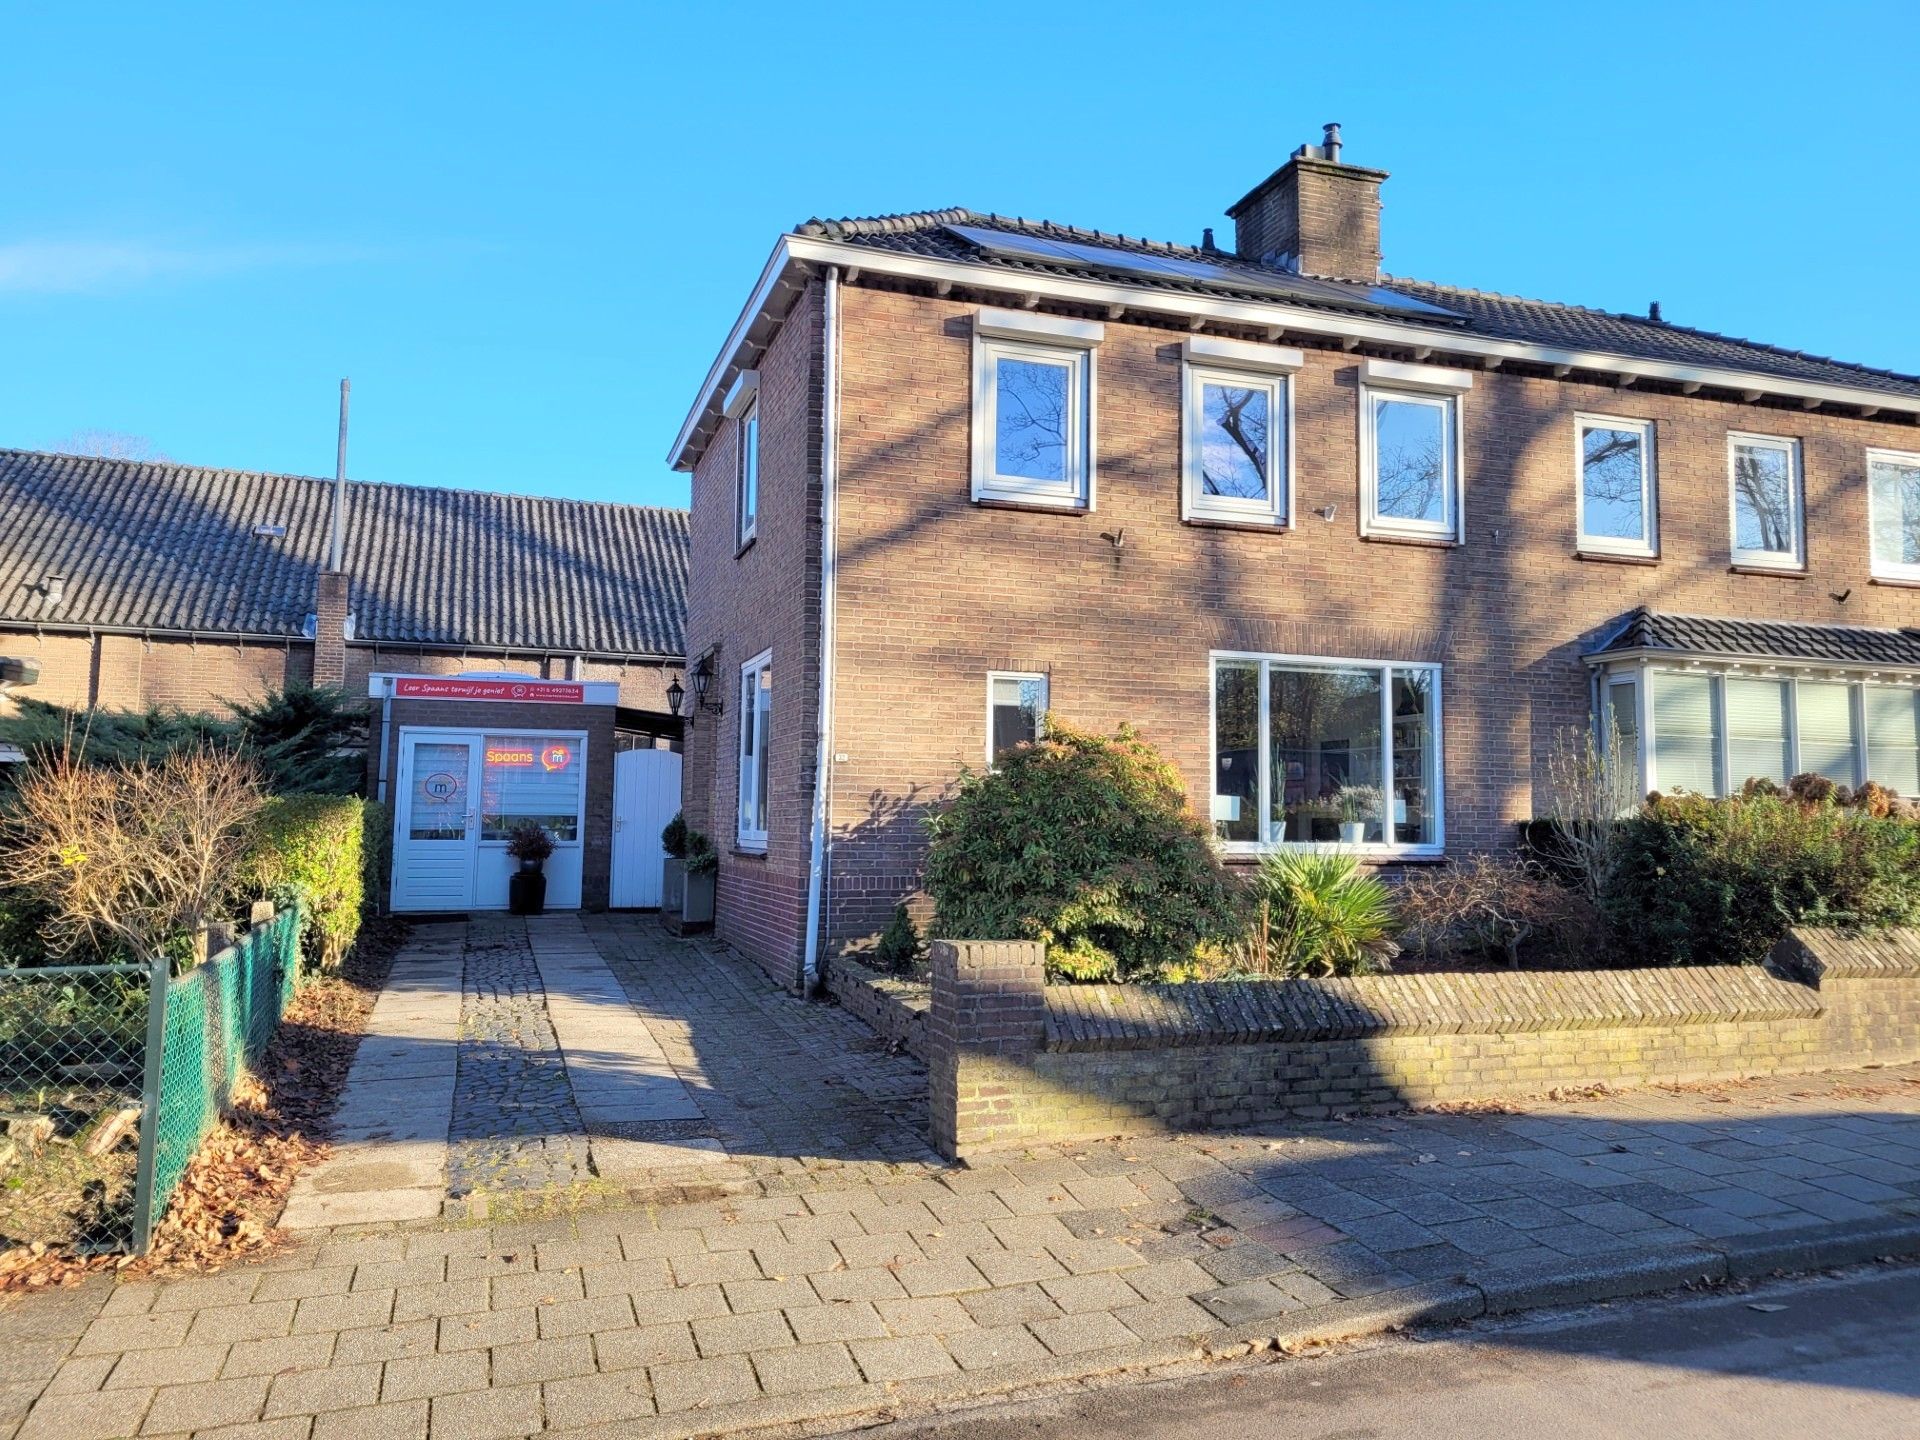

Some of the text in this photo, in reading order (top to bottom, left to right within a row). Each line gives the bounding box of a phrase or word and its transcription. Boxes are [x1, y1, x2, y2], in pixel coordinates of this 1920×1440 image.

[422, 684, 448, 692] Spaans
[487, 751, 533, 763] Spaans
[434, 784, 447, 793] m
